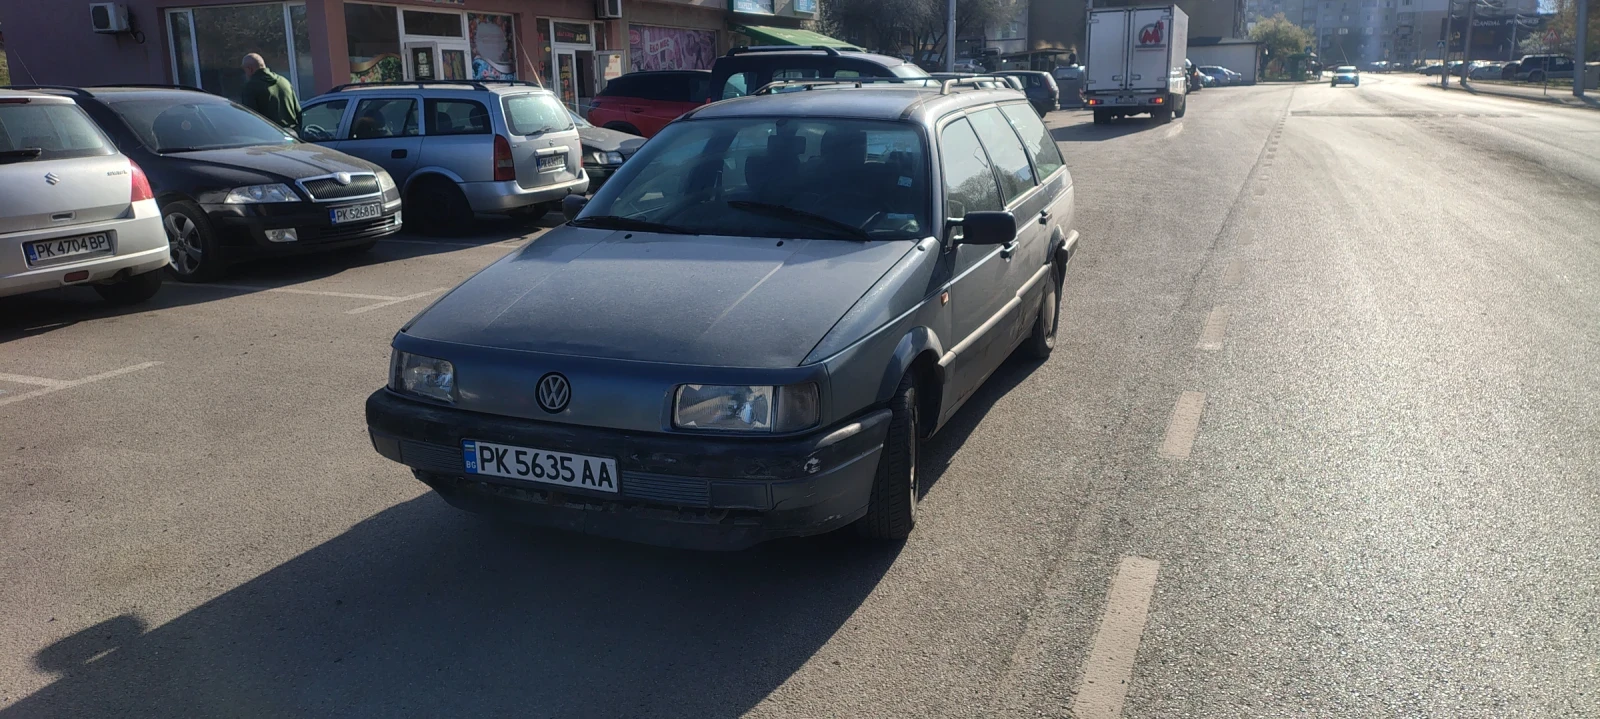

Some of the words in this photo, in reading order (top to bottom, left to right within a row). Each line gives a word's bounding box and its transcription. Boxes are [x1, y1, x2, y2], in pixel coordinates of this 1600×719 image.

[336, 209, 349, 221] PK
[349, 206, 370, 219] 5268
[369, 204, 380, 216] BT
[35, 242, 55, 258] PK
[57, 237, 88, 254] 4704
[88, 235, 106, 250] BP
[465, 460, 477, 469] BG
[479, 445, 512, 475] PK
[515, 450, 576, 483] 5635
[581, 460, 614, 489] AA
